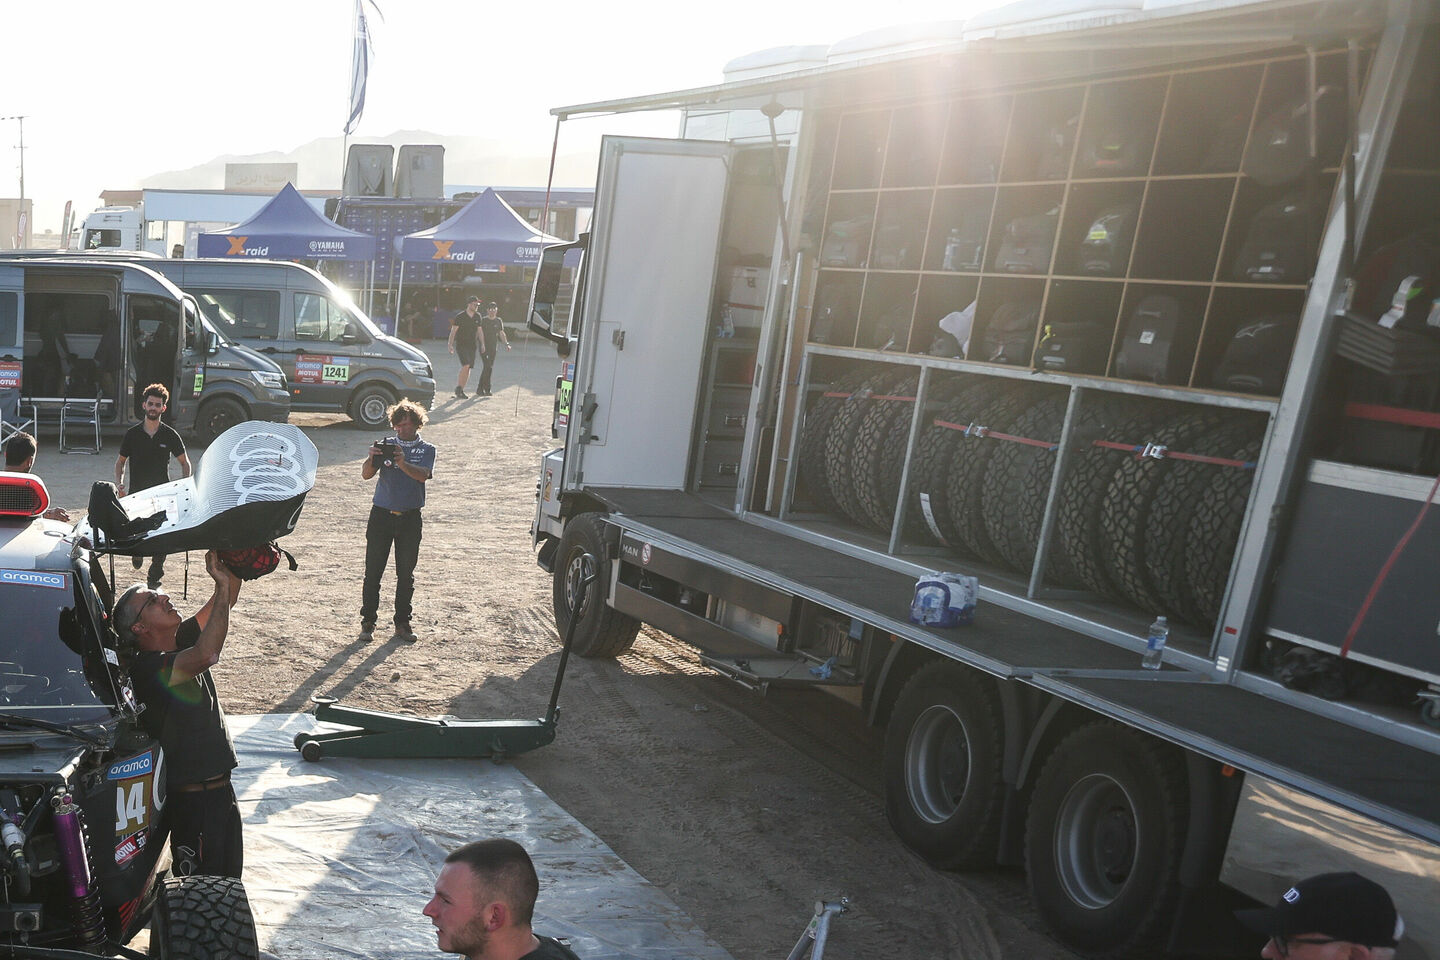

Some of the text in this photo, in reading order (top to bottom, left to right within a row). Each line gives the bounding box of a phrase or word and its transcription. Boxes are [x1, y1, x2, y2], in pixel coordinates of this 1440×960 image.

[317, 241, 345, 249] YAMAHA
[324, 367, 347, 378] 1241
[622, 543, 639, 558] MAN
[3, 572, 60, 584] aramco
[110, 758, 150, 775] aramco
[115, 841, 136, 862] MOTUL
